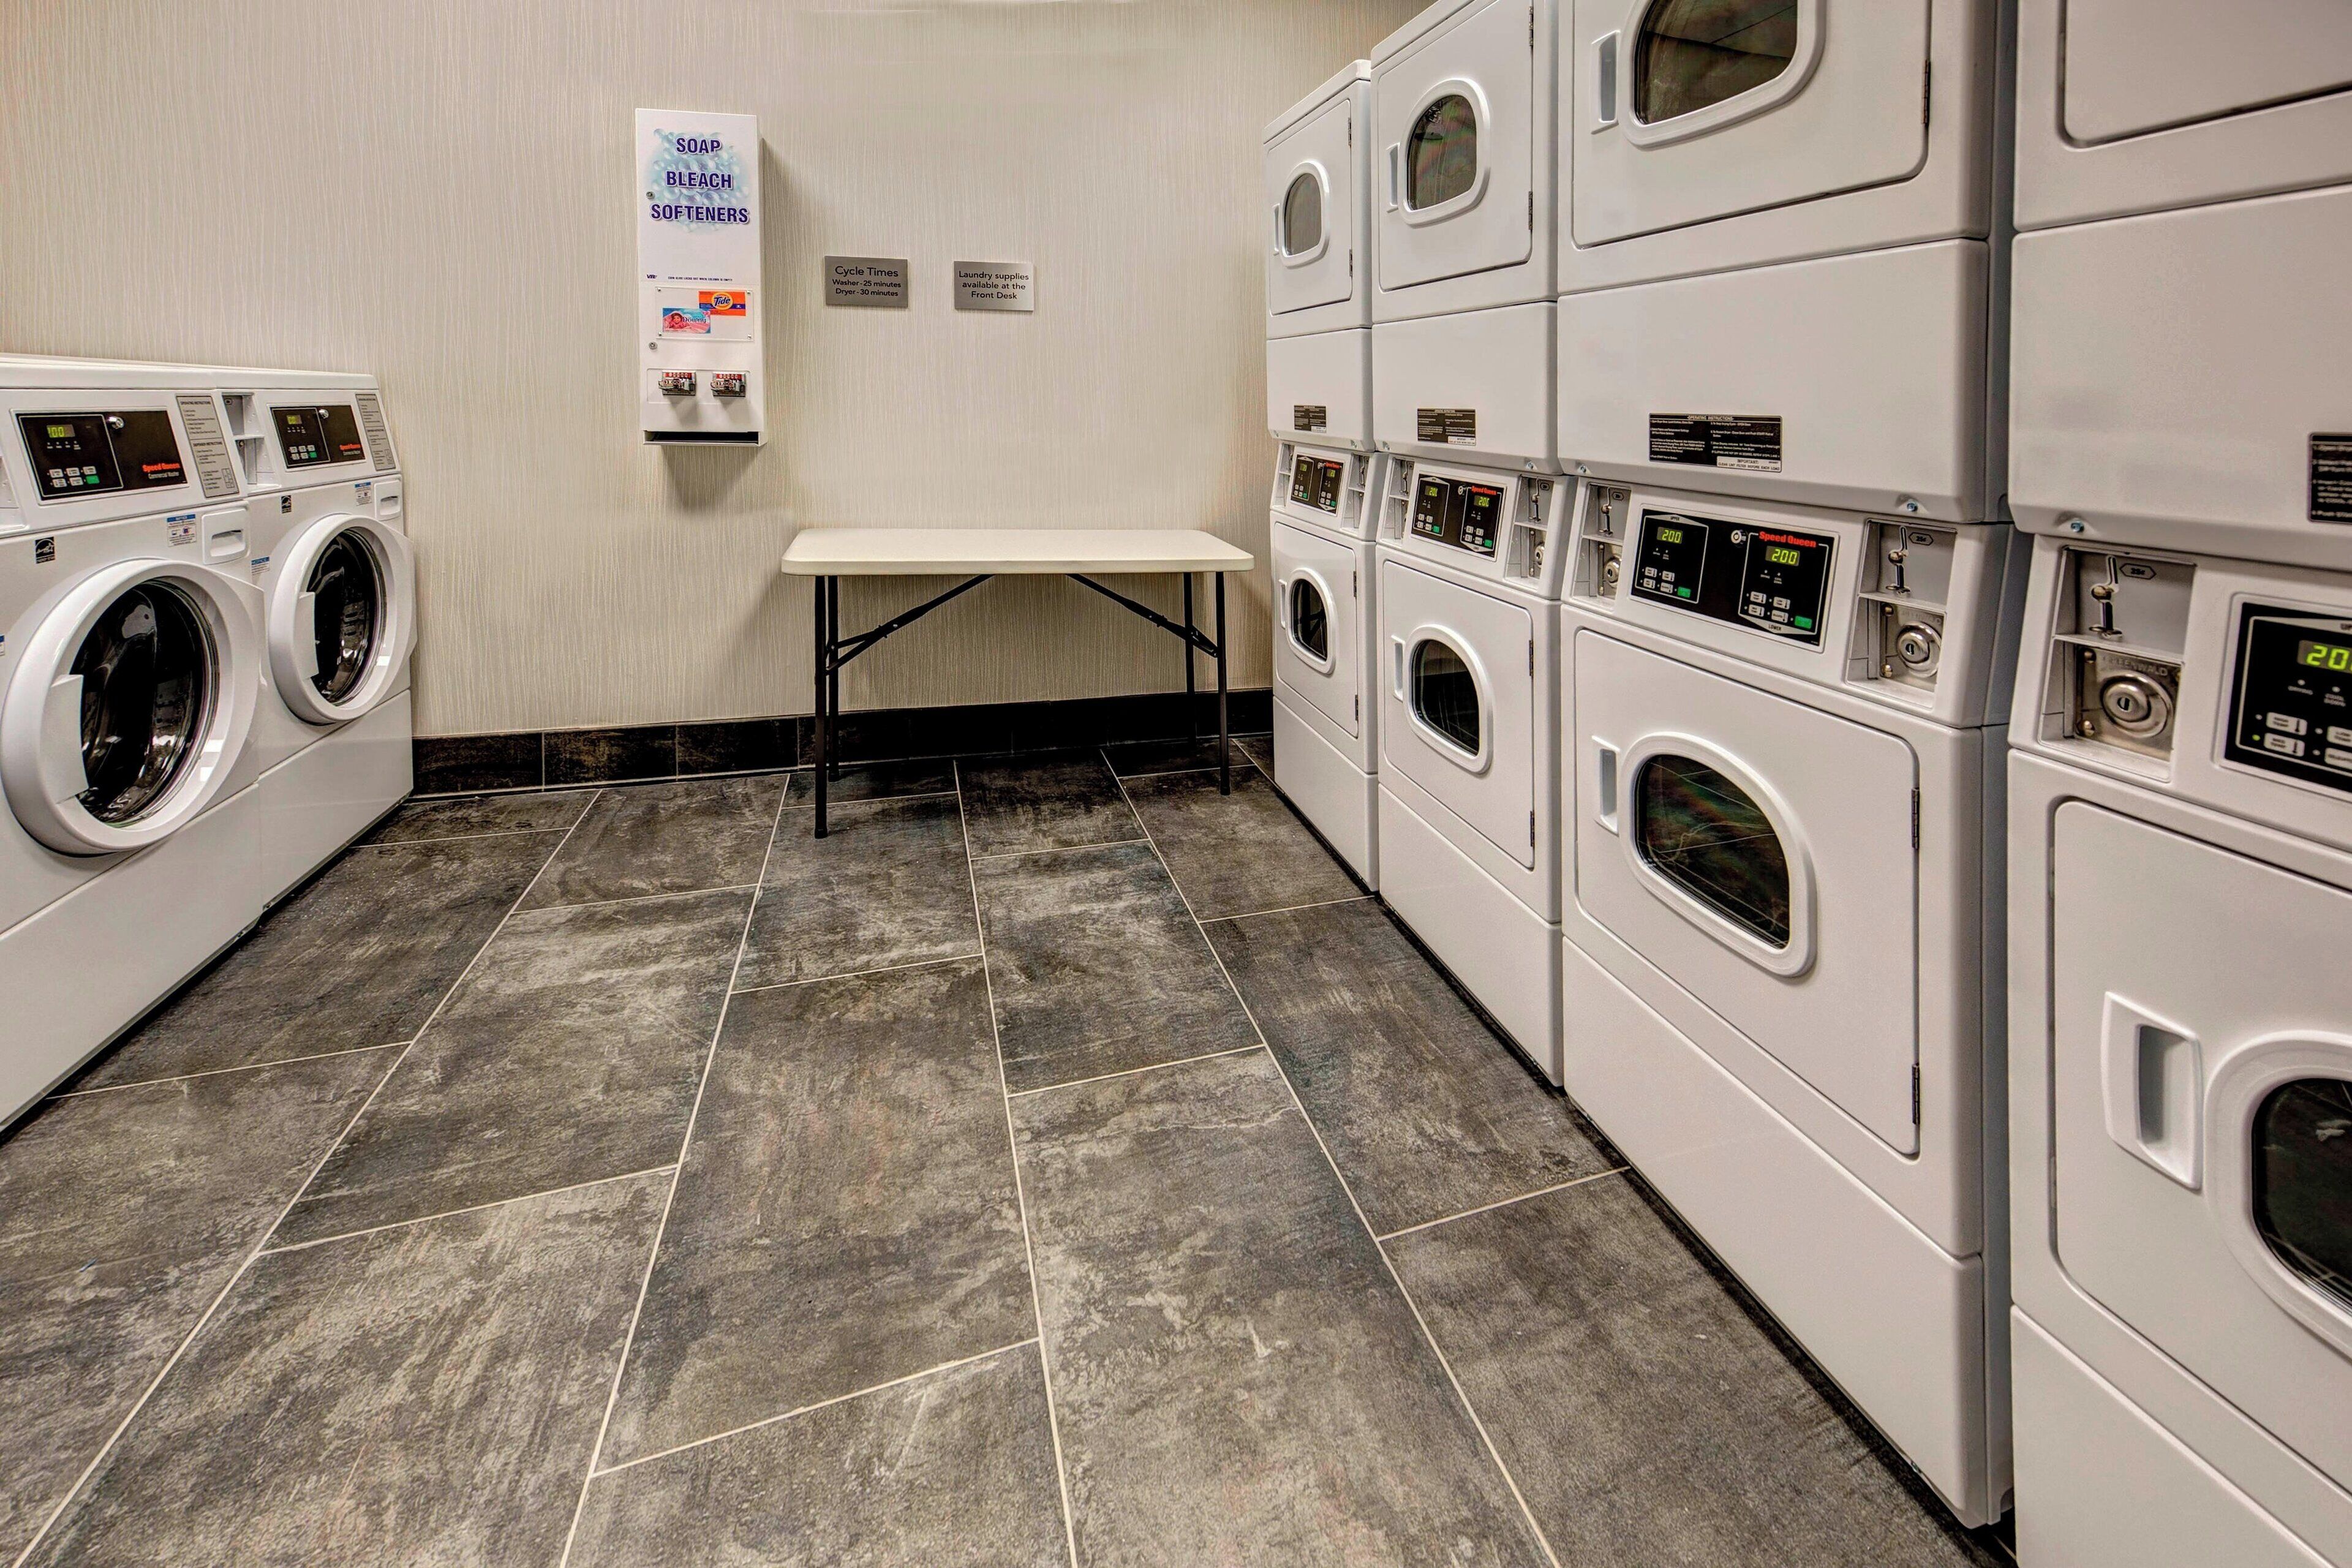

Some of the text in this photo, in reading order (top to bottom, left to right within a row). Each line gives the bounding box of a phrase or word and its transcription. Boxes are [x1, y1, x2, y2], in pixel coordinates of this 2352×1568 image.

[676, 137, 721, 154] SOAP
[666, 171, 732, 188] BLEACH
[651, 203, 748, 223] SOFTENERS
[835, 265, 899, 277] Cycle Times
[959, 270, 1029, 281] Laundry supplies
[714, 296, 731, 306] Tide
[1662, 529, 1682, 543] 200
[1759, 530, 1816, 548] Speed Queen
[1771, 549, 1798, 564] 200
[2307, 644, 2352, 673] 20
